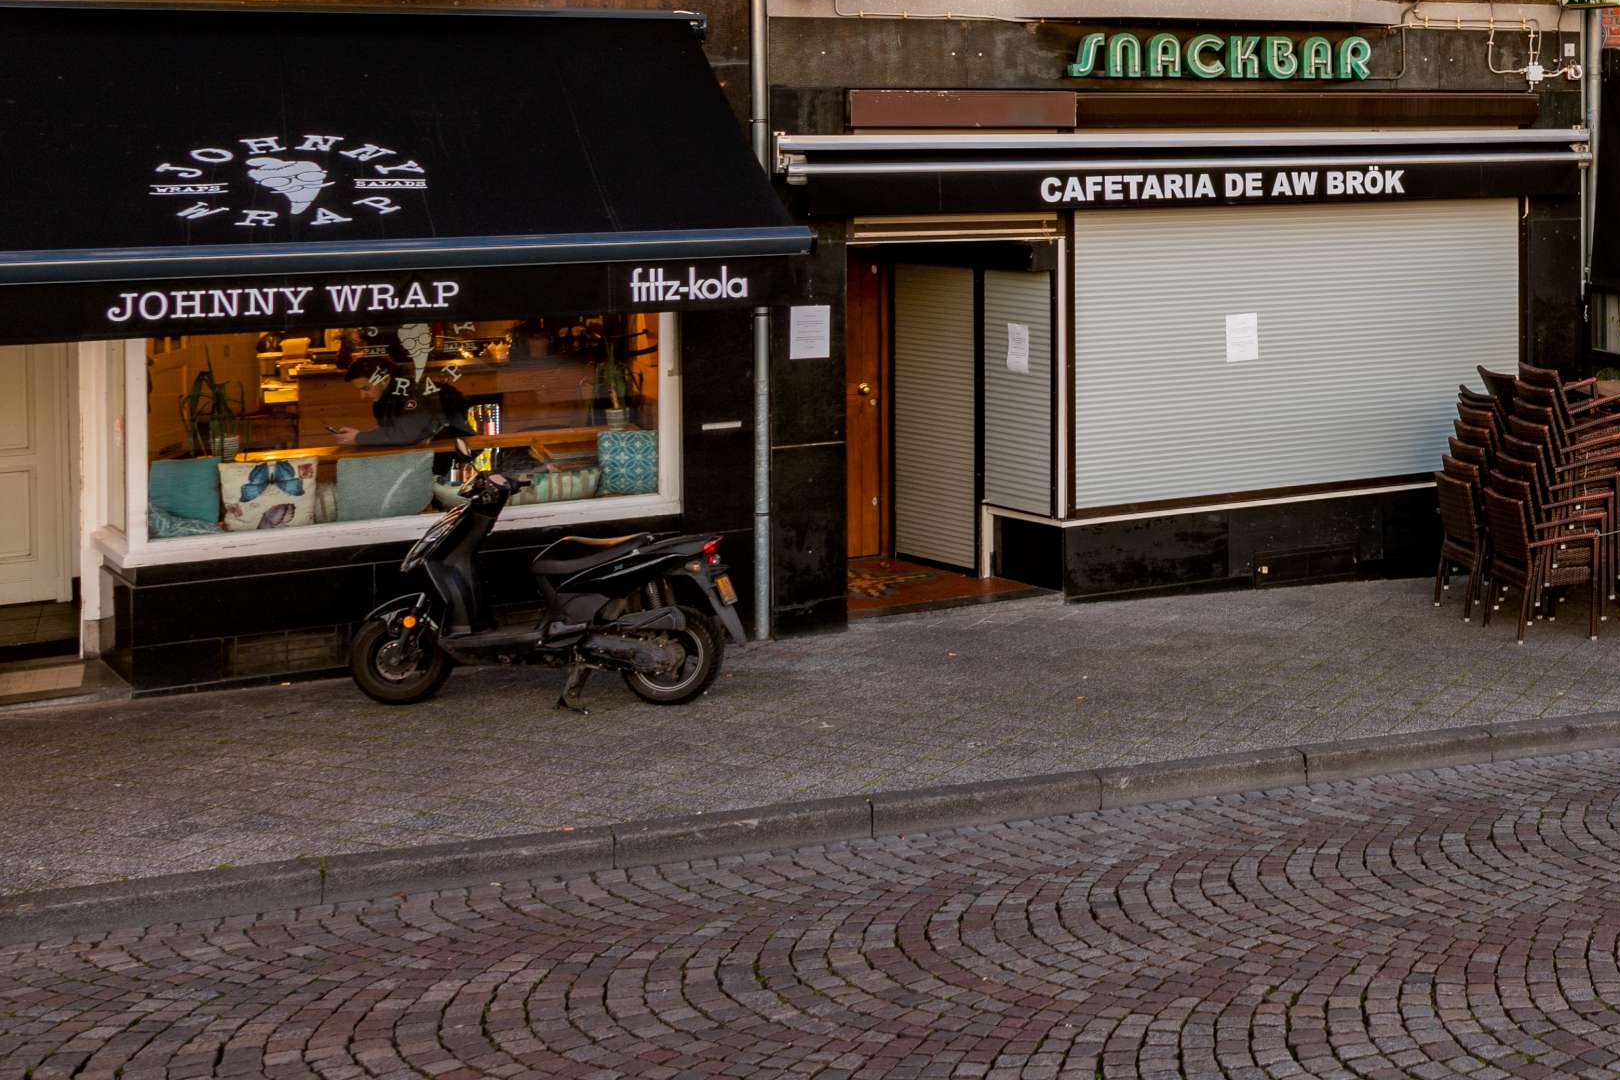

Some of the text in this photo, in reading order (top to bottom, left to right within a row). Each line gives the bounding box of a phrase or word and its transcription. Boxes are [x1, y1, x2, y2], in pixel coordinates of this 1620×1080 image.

[1067, 32, 1372, 80] SNACKBAR
[155, 135, 425, 179] JOHNNY
[155, 185, 221, 193] WRAPS
[354, 179, 426, 188] SALADS
[1040, 166, 1405, 203] CAFETARIA DE AW BRÖK
[176, 197, 402, 227] WRAP
[107, 281, 460, 322] JOHNNY WRAP
[630, 265, 749, 302] fritz-kola
